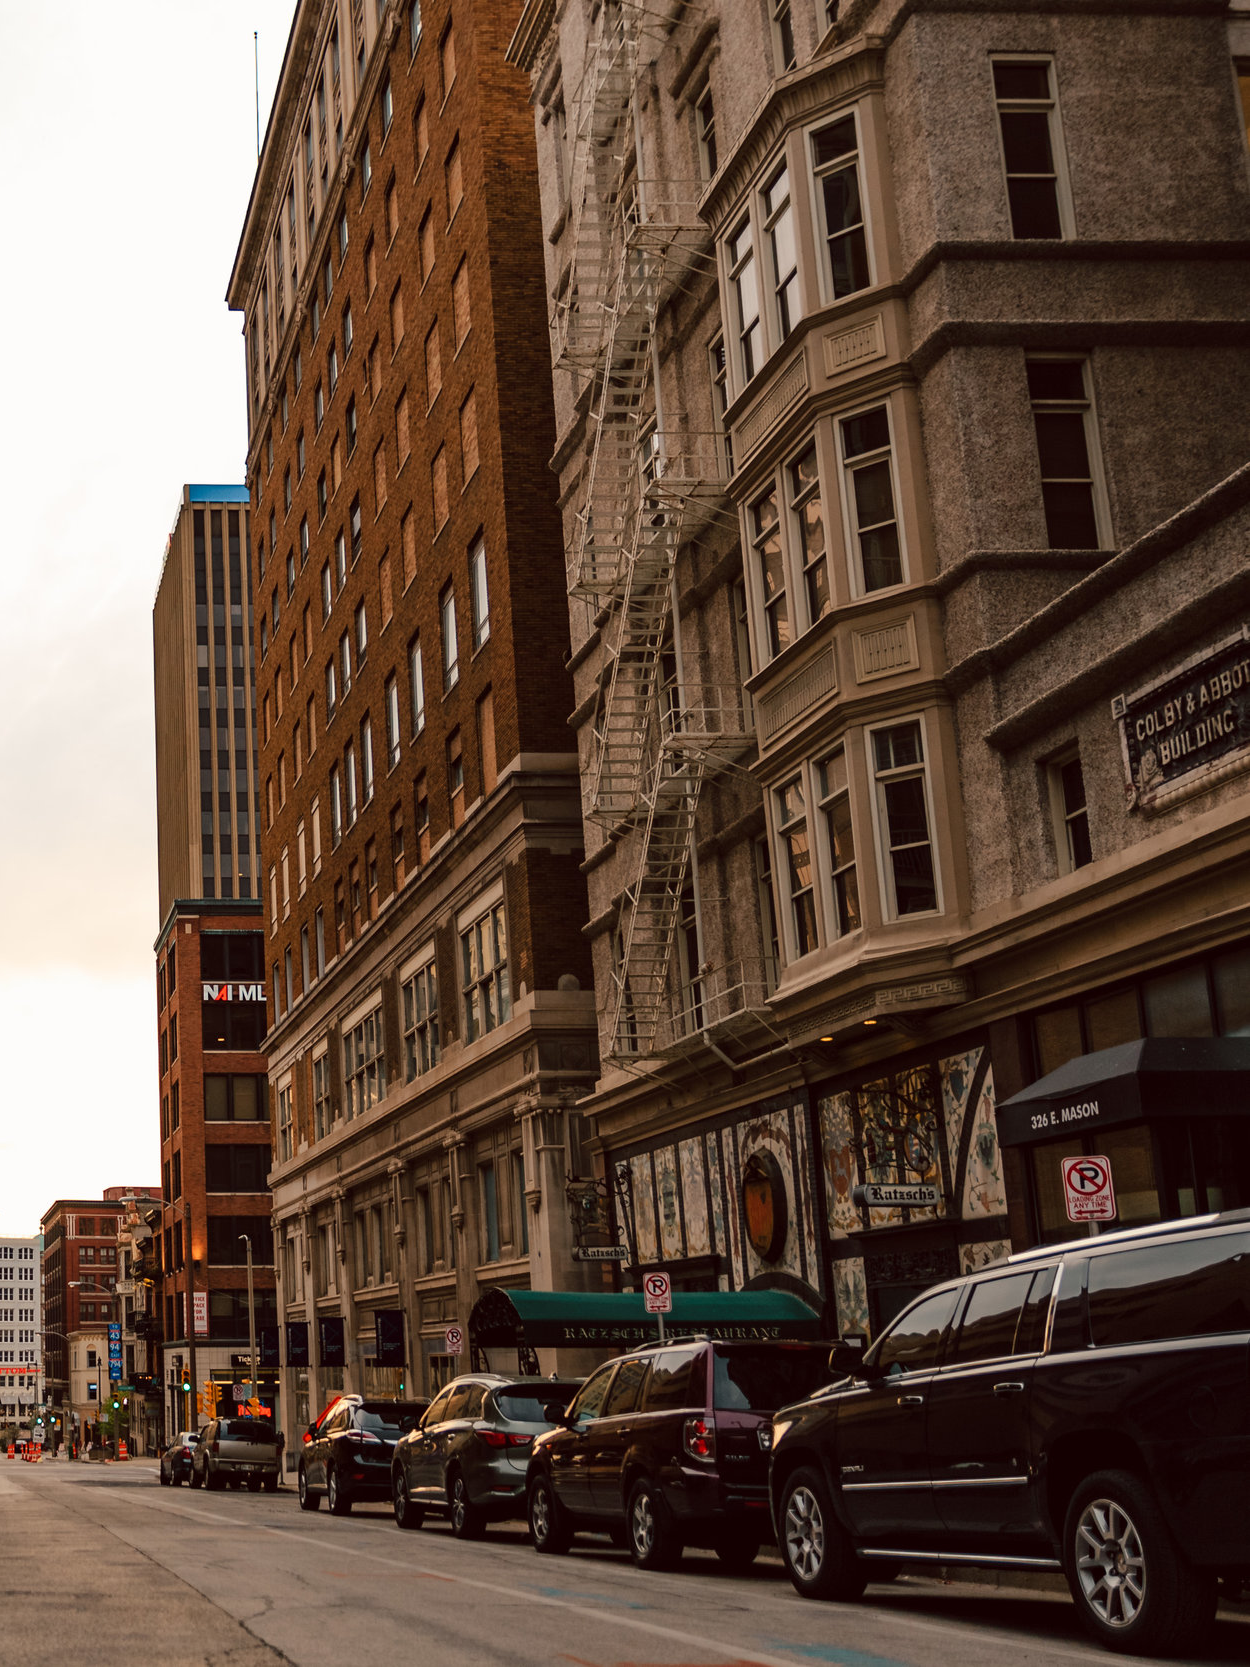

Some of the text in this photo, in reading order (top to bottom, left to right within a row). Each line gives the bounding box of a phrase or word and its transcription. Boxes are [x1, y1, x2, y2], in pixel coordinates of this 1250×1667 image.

[1136, 697, 1183, 741] COLBY
[1186, 692, 1196, 714] &
[1160, 709, 1235, 766] BUILDING
[203, 984, 233, 1001] NAI
[1031, 1101, 1100, 1129] 326 E. MASON
[871, 1186, 936, 1203] Ratzsch's
[1069, 1194, 1110, 1204] LOADING ZONE
[663, 1327, 781, 1340] RESTAURANT
[110, 1360, 121, 1368] 794
